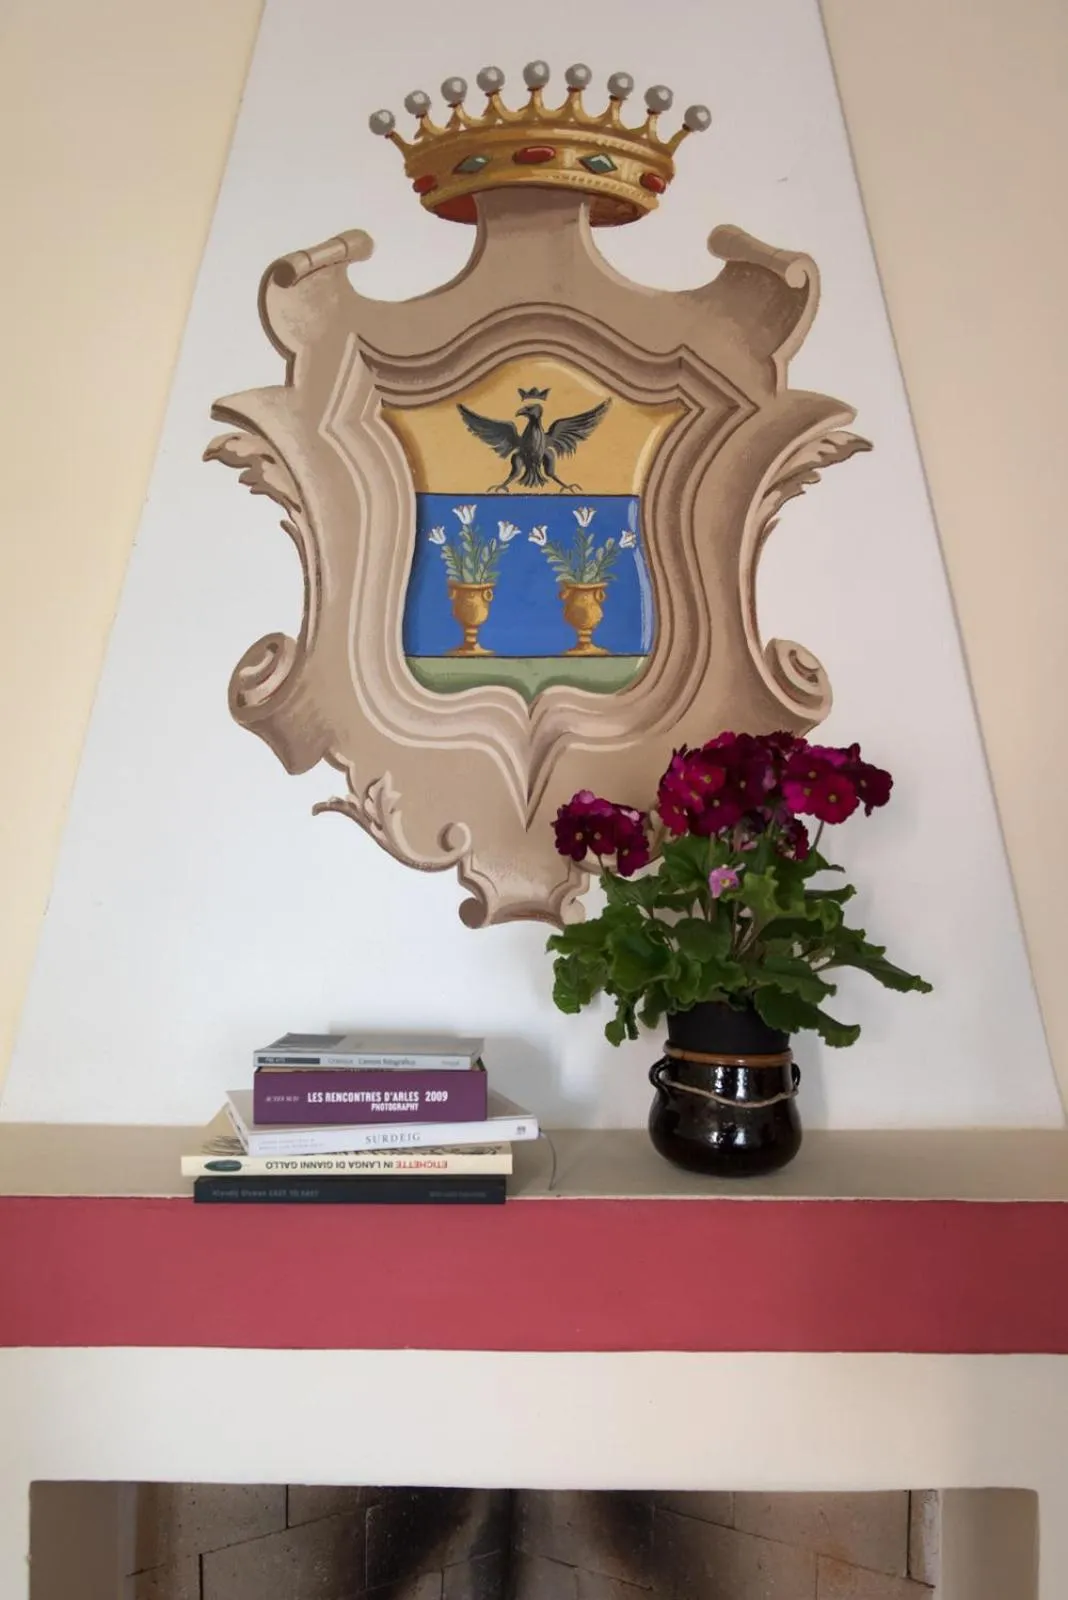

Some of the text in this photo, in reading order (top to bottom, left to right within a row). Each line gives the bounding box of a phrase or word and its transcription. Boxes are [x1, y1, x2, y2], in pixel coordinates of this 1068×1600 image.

[307, 1091, 323, 1103] LES
[325, 1091, 382, 1103] RENCONTRES
[384, 1091, 420, 1102] D'ARLES
[425, 1090, 449, 1102] 2009
[371, 1102, 420, 1111] PHOTOGRAPHY
[365, 1132, 421, 1145] SURDEIG
[265, 1160, 448, 1170] ETICHETTE IN LANGA DI GIANNI GALLO
